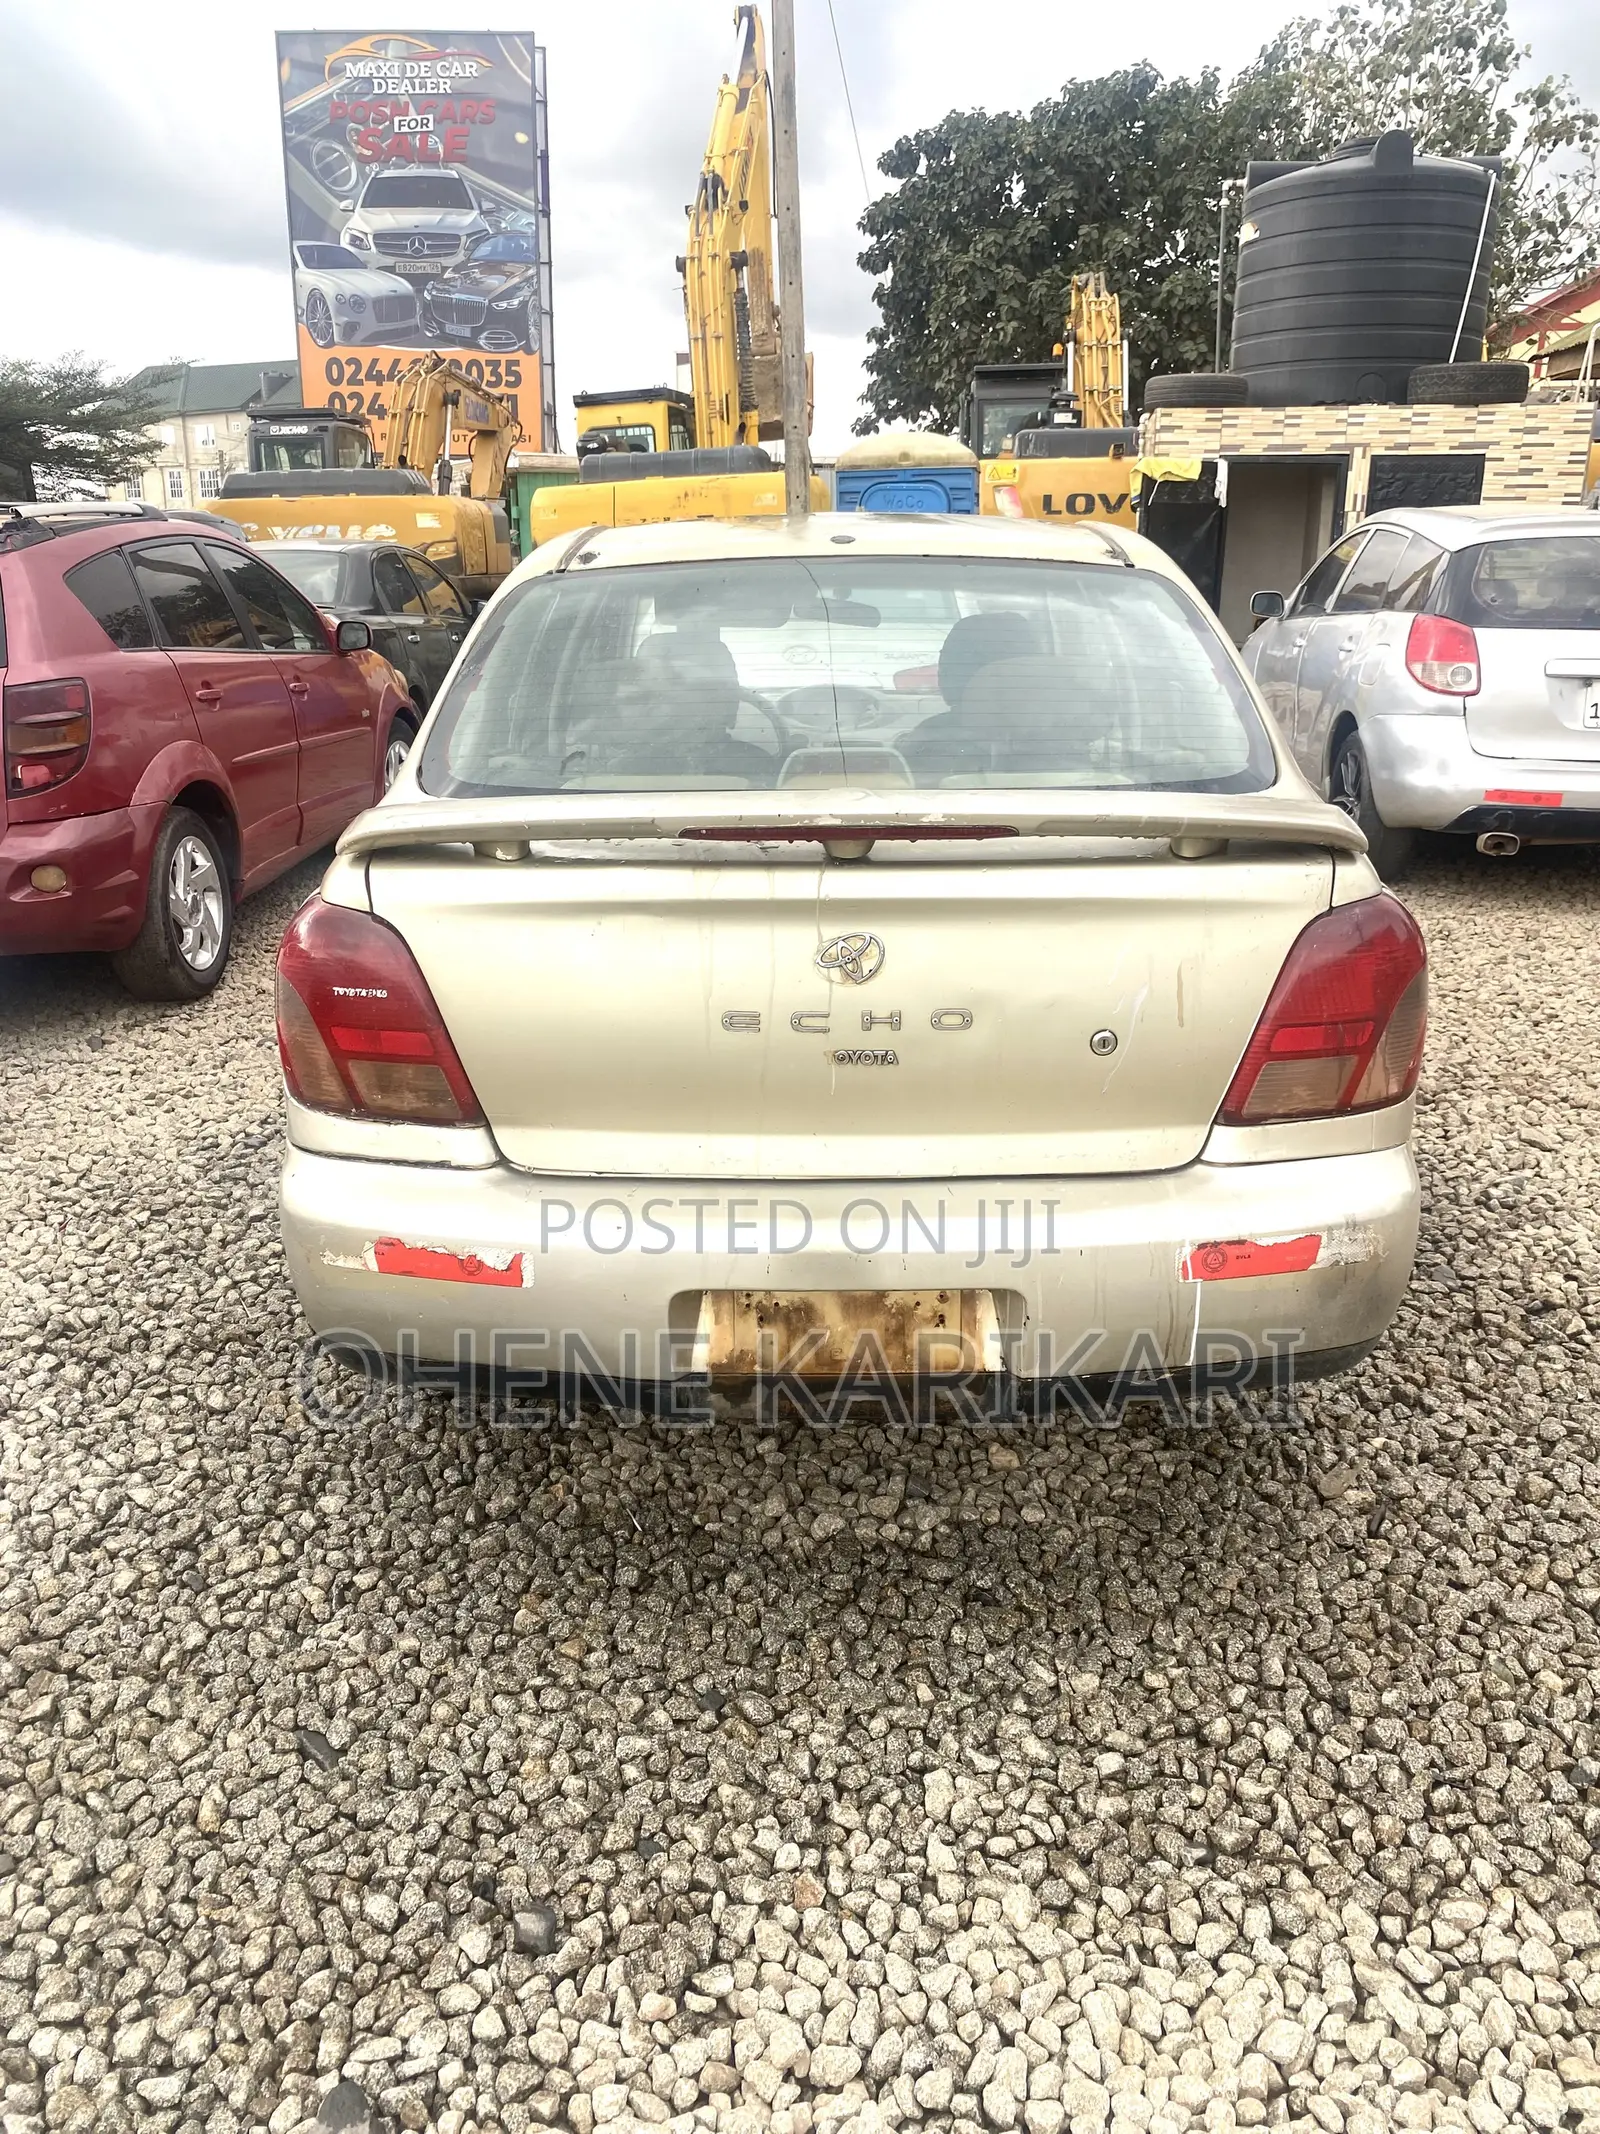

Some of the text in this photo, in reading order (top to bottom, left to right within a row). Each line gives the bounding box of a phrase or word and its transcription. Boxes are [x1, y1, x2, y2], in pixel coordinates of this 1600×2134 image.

[344, 61, 479, 78] MAXI DE CAR
[372, 78, 453, 94] DEALER
[329, 98, 497, 125] POSH CARS
[397, 117, 431, 132] FOR
[356, 127, 470, 164] SALE
[721, 1008, 973, 1034] ECHO
